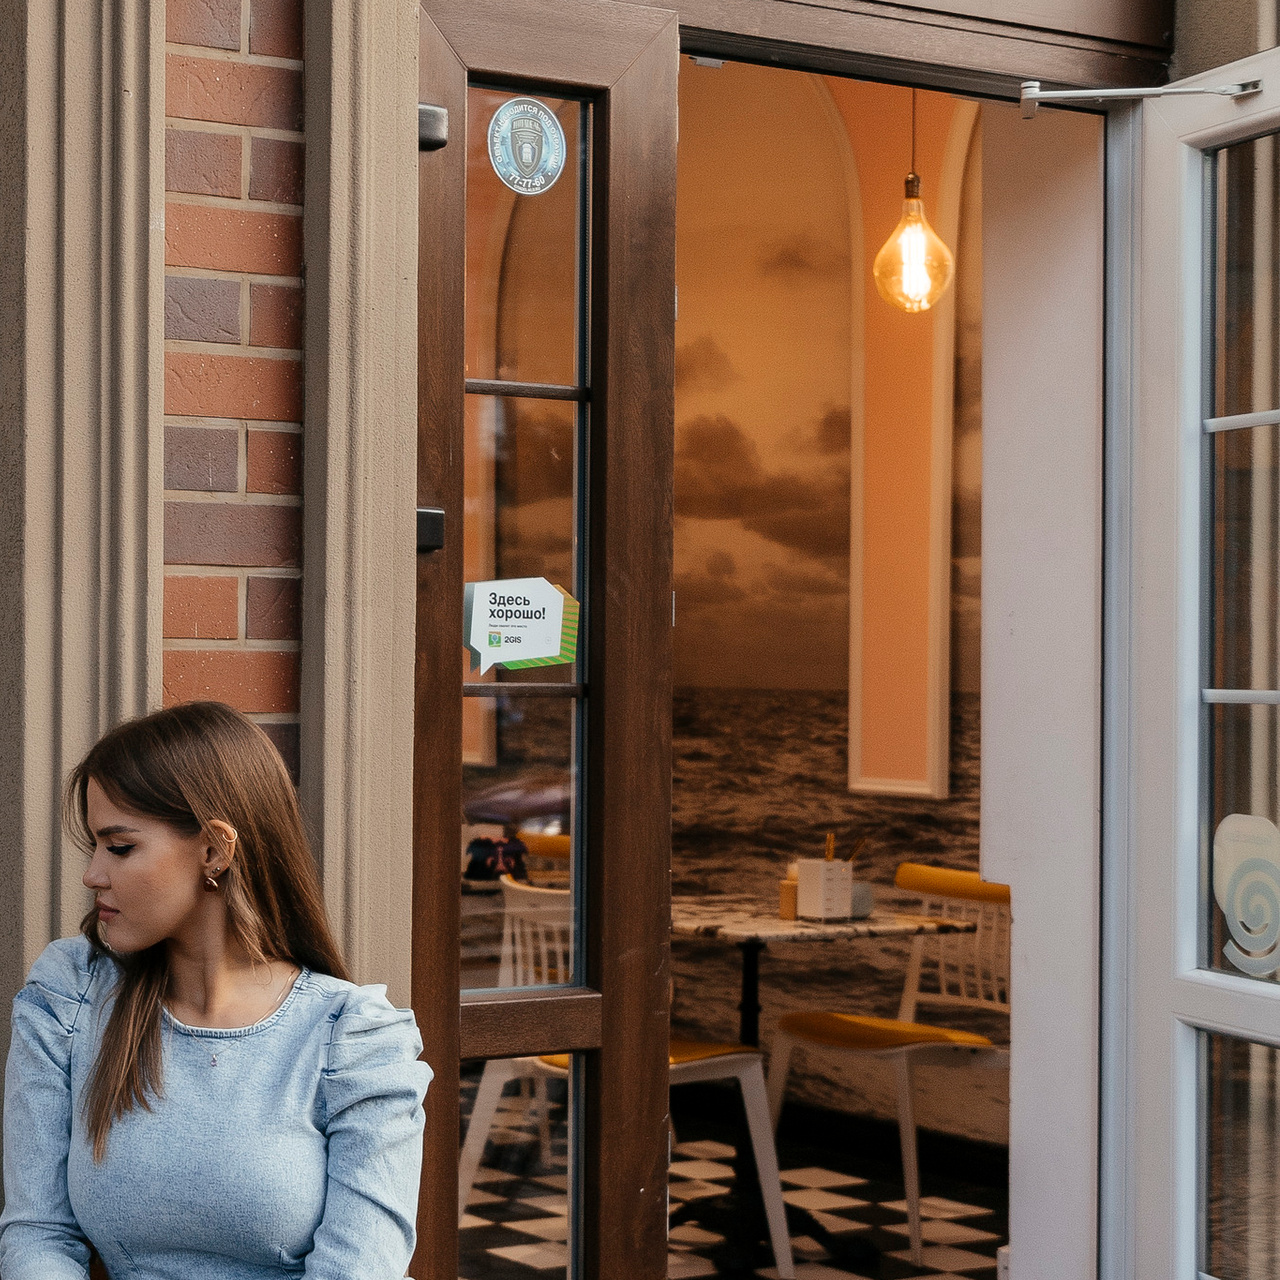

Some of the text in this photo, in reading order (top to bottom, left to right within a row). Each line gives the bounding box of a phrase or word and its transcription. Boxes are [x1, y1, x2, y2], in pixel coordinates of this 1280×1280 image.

[538, 110, 552, 127] ПОД
[509, 172, 545, 187] 77-77-60
[488, 592, 531, 607] Здесь
[488, 607, 546, 621] хорошо!
[504, 635, 522, 644] 2GIS
